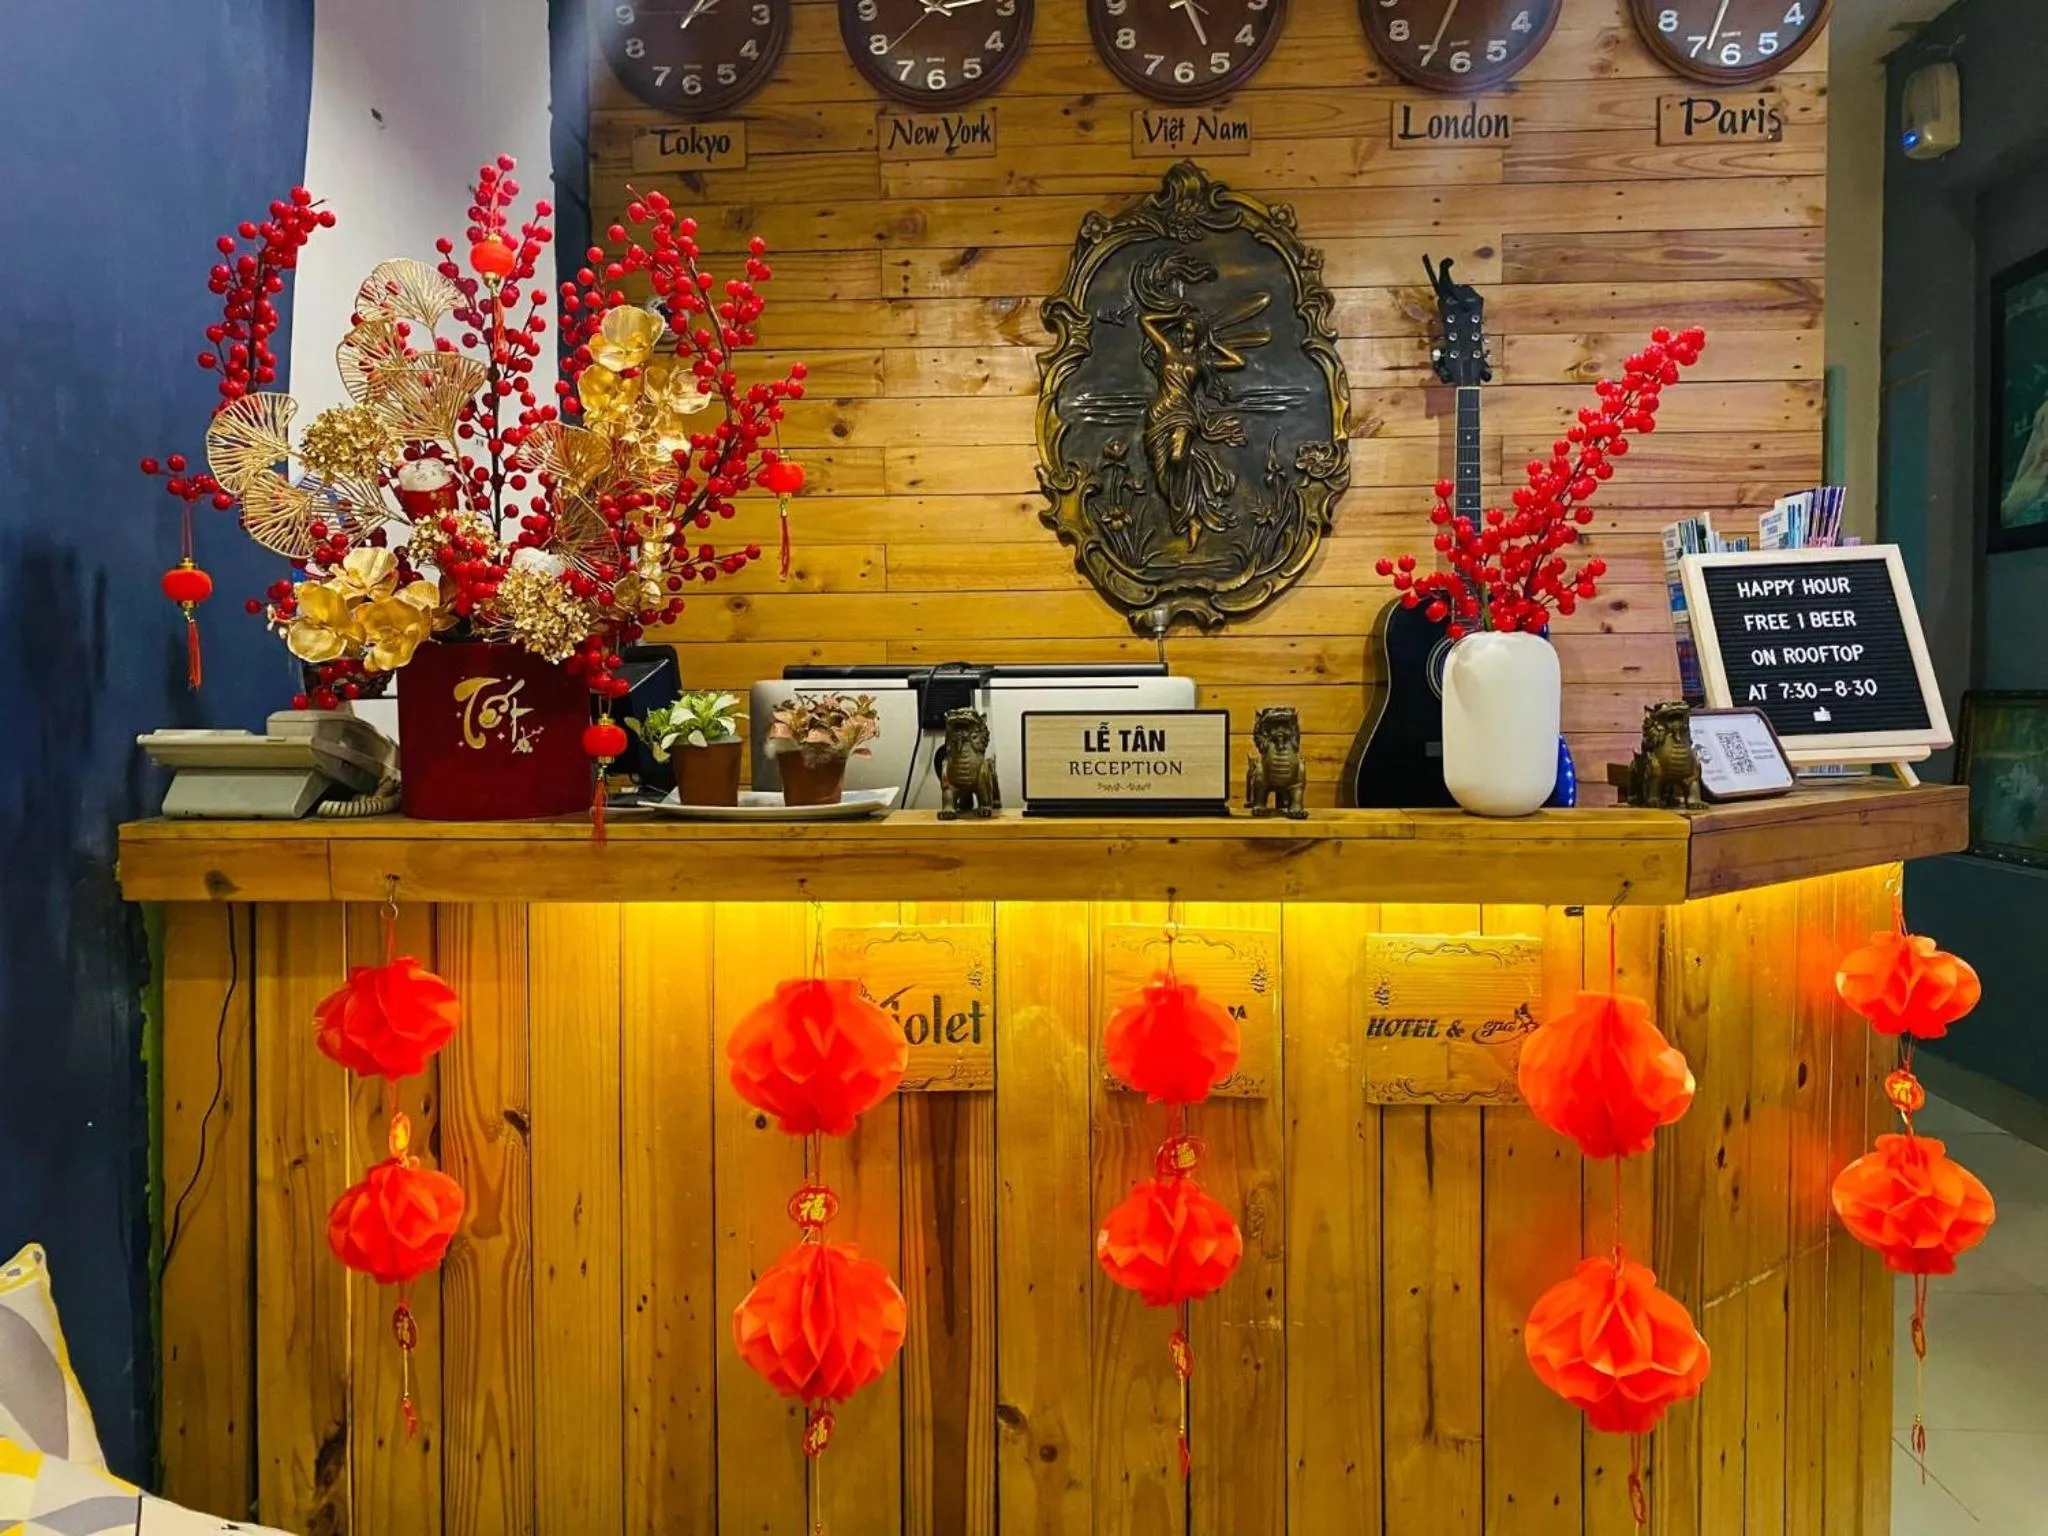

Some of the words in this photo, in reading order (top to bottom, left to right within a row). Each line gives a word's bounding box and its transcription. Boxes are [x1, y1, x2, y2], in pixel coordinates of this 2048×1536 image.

[615, 4, 635, 25] 9
[751, 4, 770, 25] 3
[1511, 10, 1532, 33] 4
[1658, 9, 1679, 32] 8
[1783, 2, 1805, 26] 4
[984, 30, 1005, 52] 4
[1115, 28, 1136, 50] 8
[1234, 24, 1256, 46] 4
[1389, 19, 1410, 41] 8
[625, 37, 646, 58] 8
[739, 39, 760, 61] 4
[869, 34, 888, 55] 8
[1486, 40, 1507, 62] 5
[1687, 36, 1708, 58] 7
[1720, 43, 1742, 65] 6
[1758, 31, 1779, 55] 5
[897, 60, 915, 82] 7
[963, 57, 983, 79] 5
[1143, 53, 1164, 76] 7
[1174, 62, 1195, 83] 6
[1210, 52, 1230, 73] 5
[1450, 51, 1471, 73] 6
[652, 65, 672, 87] 7
[682, 74, 702, 95] 6
[717, 63, 737, 85] 5
[926, 69, 947, 90] 6
[1398, 101, 1509, 140] London
[1679, 97, 1783, 138] Paris
[888, 118, 938, 150] New
[942, 114, 992, 156] York
[1142, 115, 1185, 150] Việt
[1192, 114, 1249, 146] Nam
[650, 126, 732, 163] Tokyo
[1736, 579, 1795, 599] HAPPY
[1802, 577, 1852, 596] HOUR
[1744, 613, 1792, 632] FREE
[1808, 610, 1857, 629] BEER
[1751, 649, 1777, 666] ON
[1783, 644, 1864, 665] ROOFTOP
[1748, 683, 1768, 701] AT
[1084, 721, 1111, 753] LỄ
[1118, 725, 1166, 753] TÂN
[1069, 760, 1183, 776] RECEPTION
[880, 984, 986, 1045] olet
[1366, 1016, 1440, 1039] HOTEL
[1446, 1019, 1465, 1038] &
